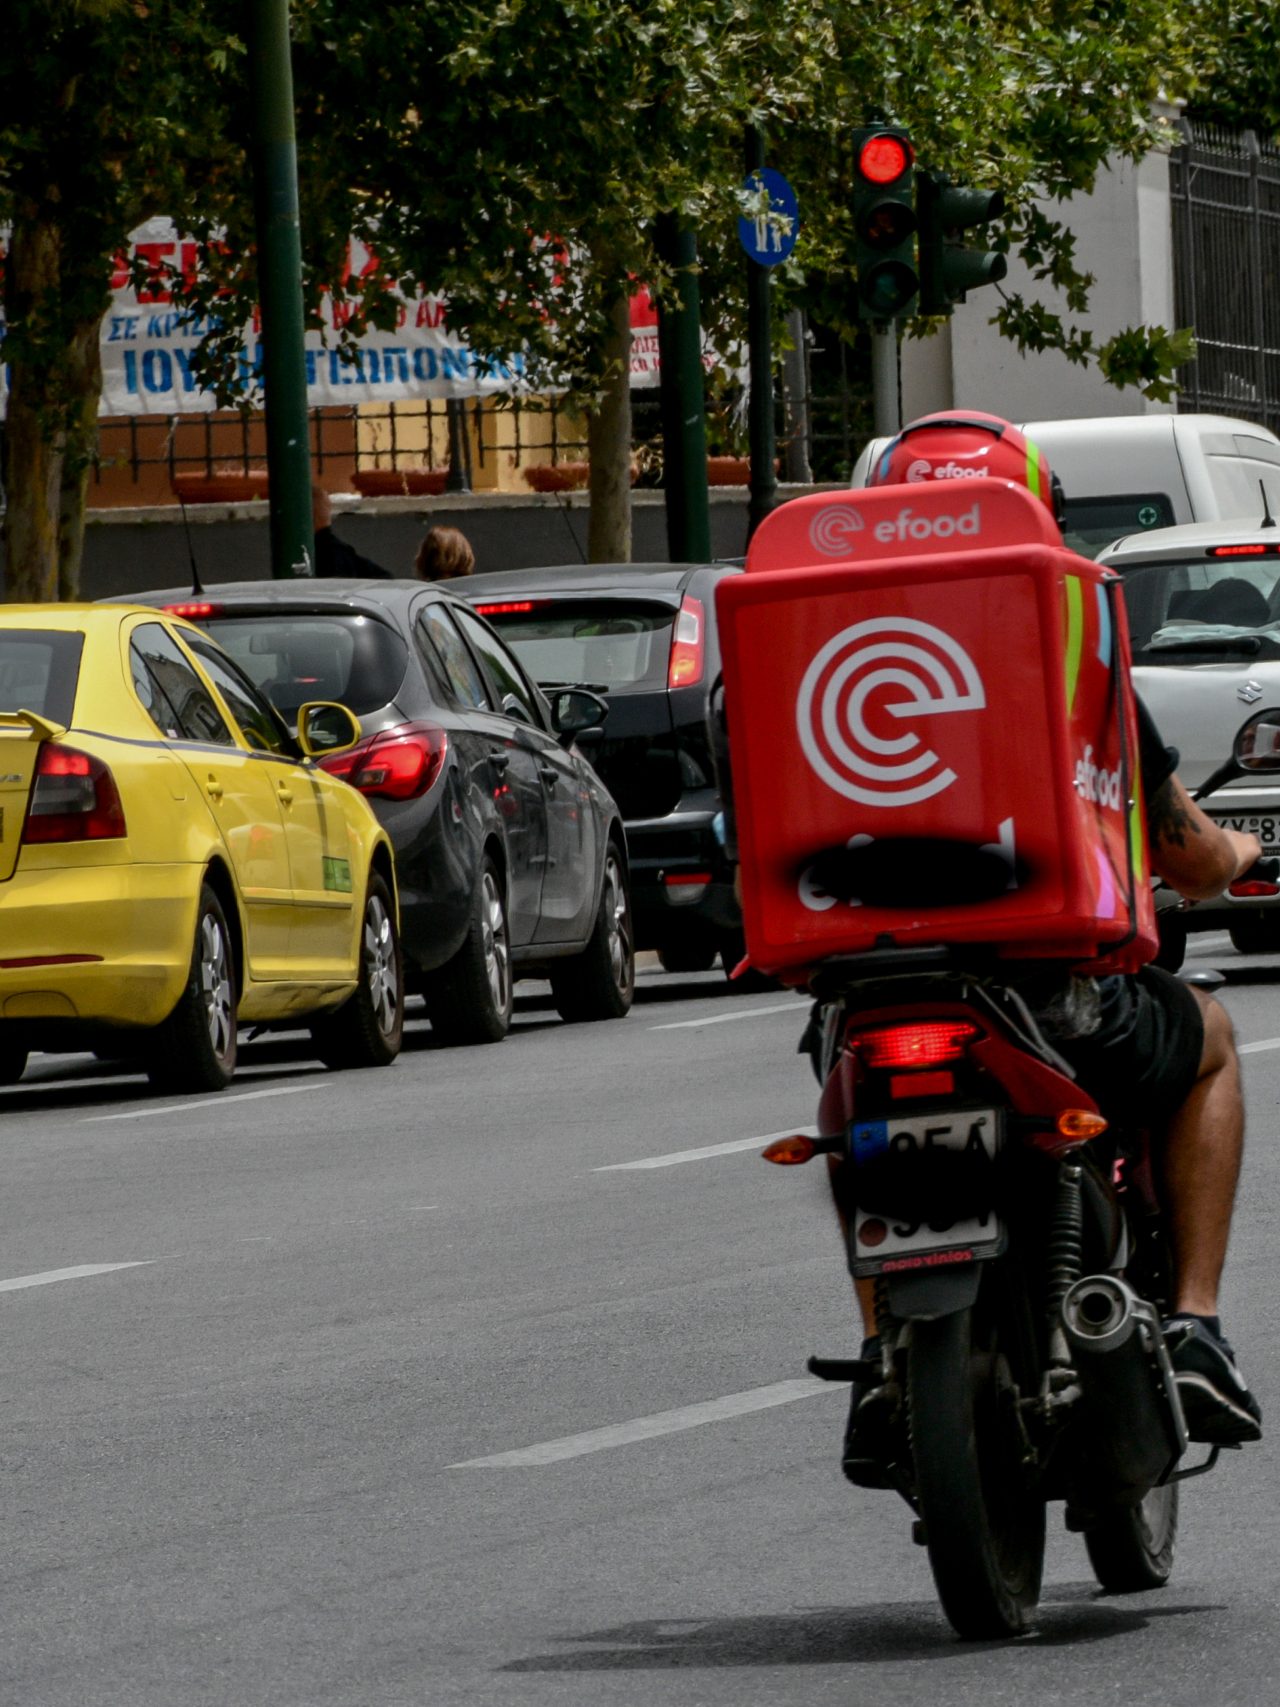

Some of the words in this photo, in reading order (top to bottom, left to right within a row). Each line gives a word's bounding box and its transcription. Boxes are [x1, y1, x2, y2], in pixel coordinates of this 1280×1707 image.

[108, 316, 139, 341] ΣΕ
[934, 461, 988, 479] efood
[875, 502, 980, 543] efood
[1076, 744, 1122, 811] efood
